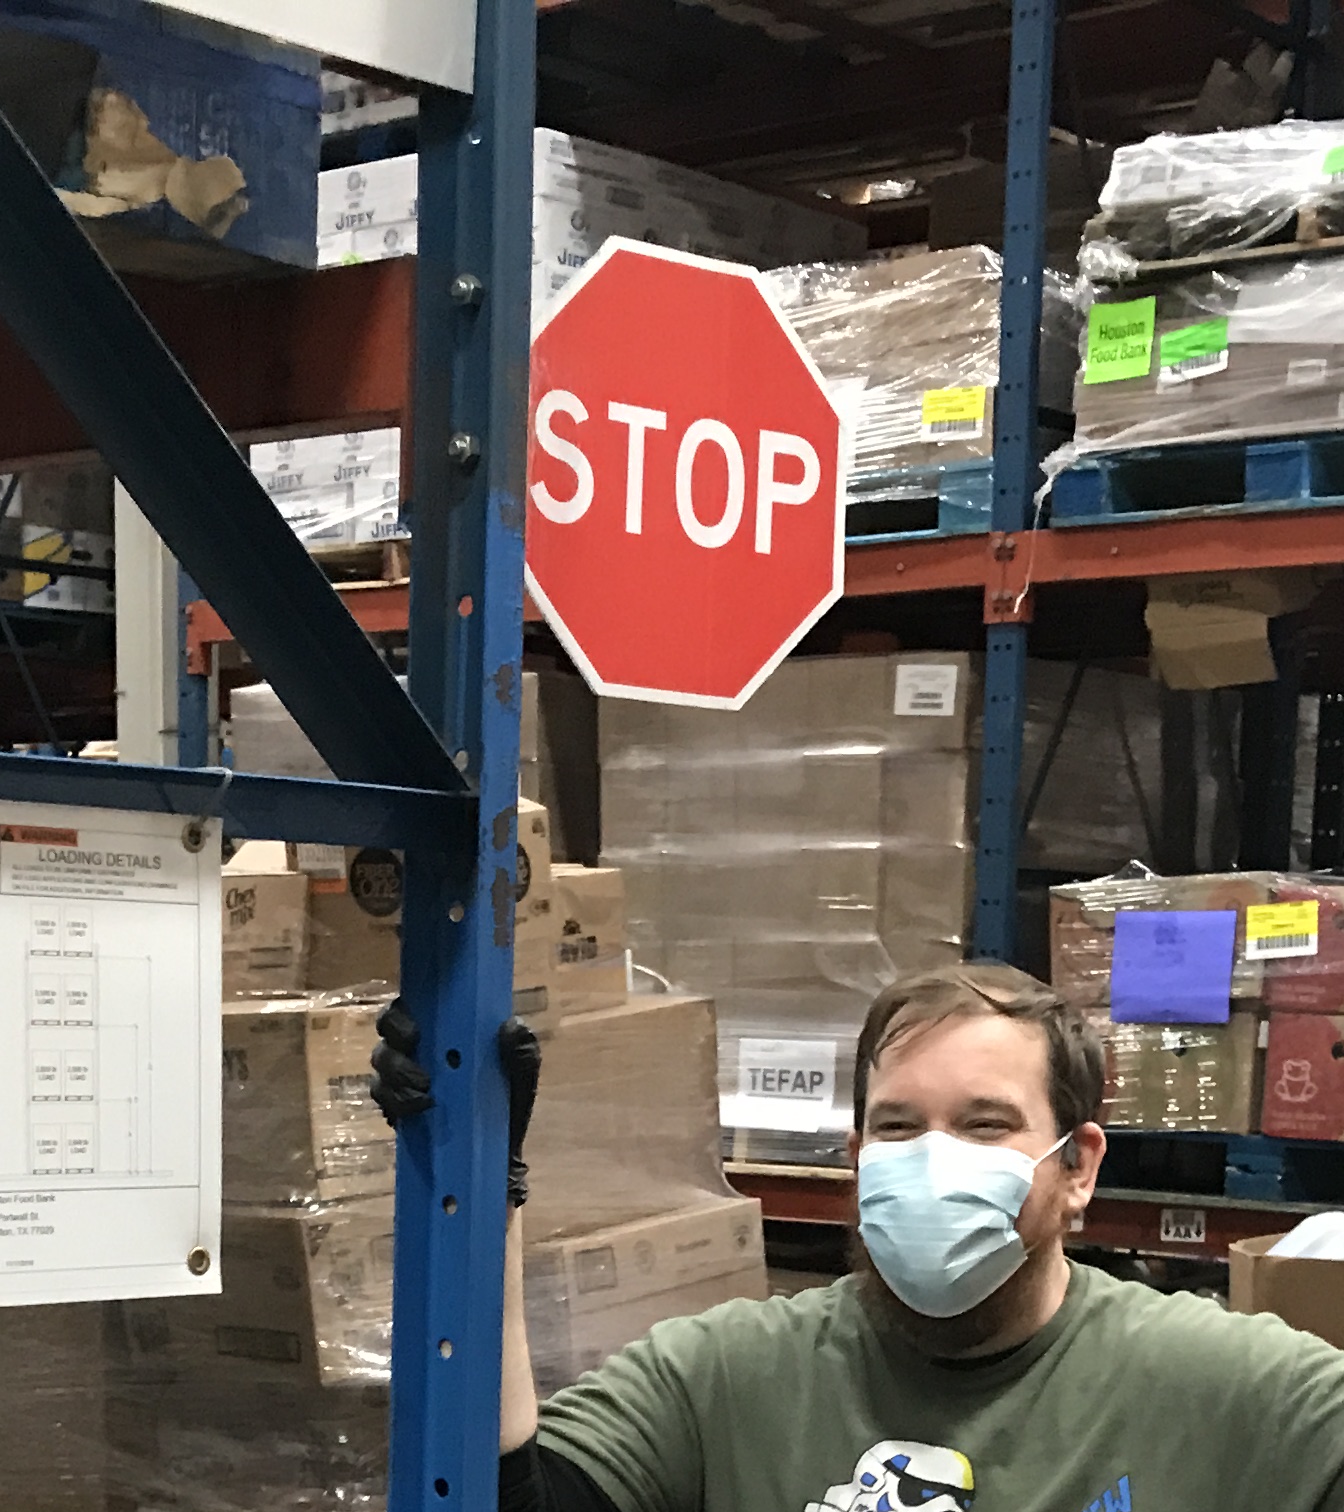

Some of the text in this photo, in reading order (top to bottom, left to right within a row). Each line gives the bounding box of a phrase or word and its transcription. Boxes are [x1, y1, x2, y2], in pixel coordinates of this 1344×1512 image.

[336, 208, 375, 231] JIFFY
[557, 248, 592, 268] JIF
[1098, 320, 1146, 341] Houston
[1089, 342, 1148, 364] Food Bank
[333, 462, 372, 482] JIFFY
[530, 388, 822, 556] STOP
[38, 848, 162, 870] LOADING DETAILS
[746, 1067, 825, 1095] TEFAP
